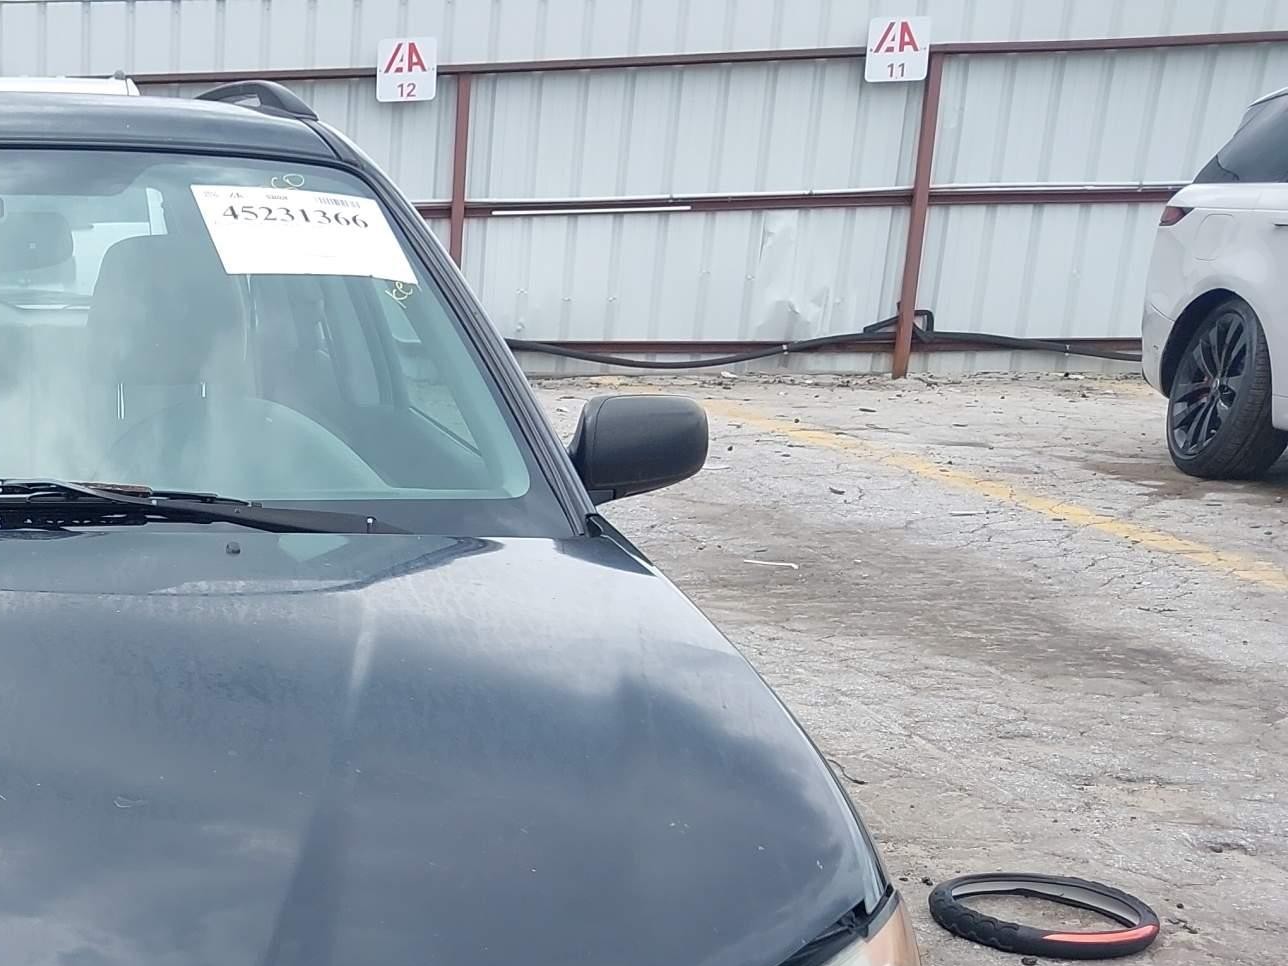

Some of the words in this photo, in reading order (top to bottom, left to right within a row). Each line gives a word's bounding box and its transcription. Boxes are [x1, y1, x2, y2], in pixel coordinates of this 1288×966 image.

[887, 62, 905, 78] 11
[397, 82, 416, 97] 12
[222, 205, 369, 229] 45231366
